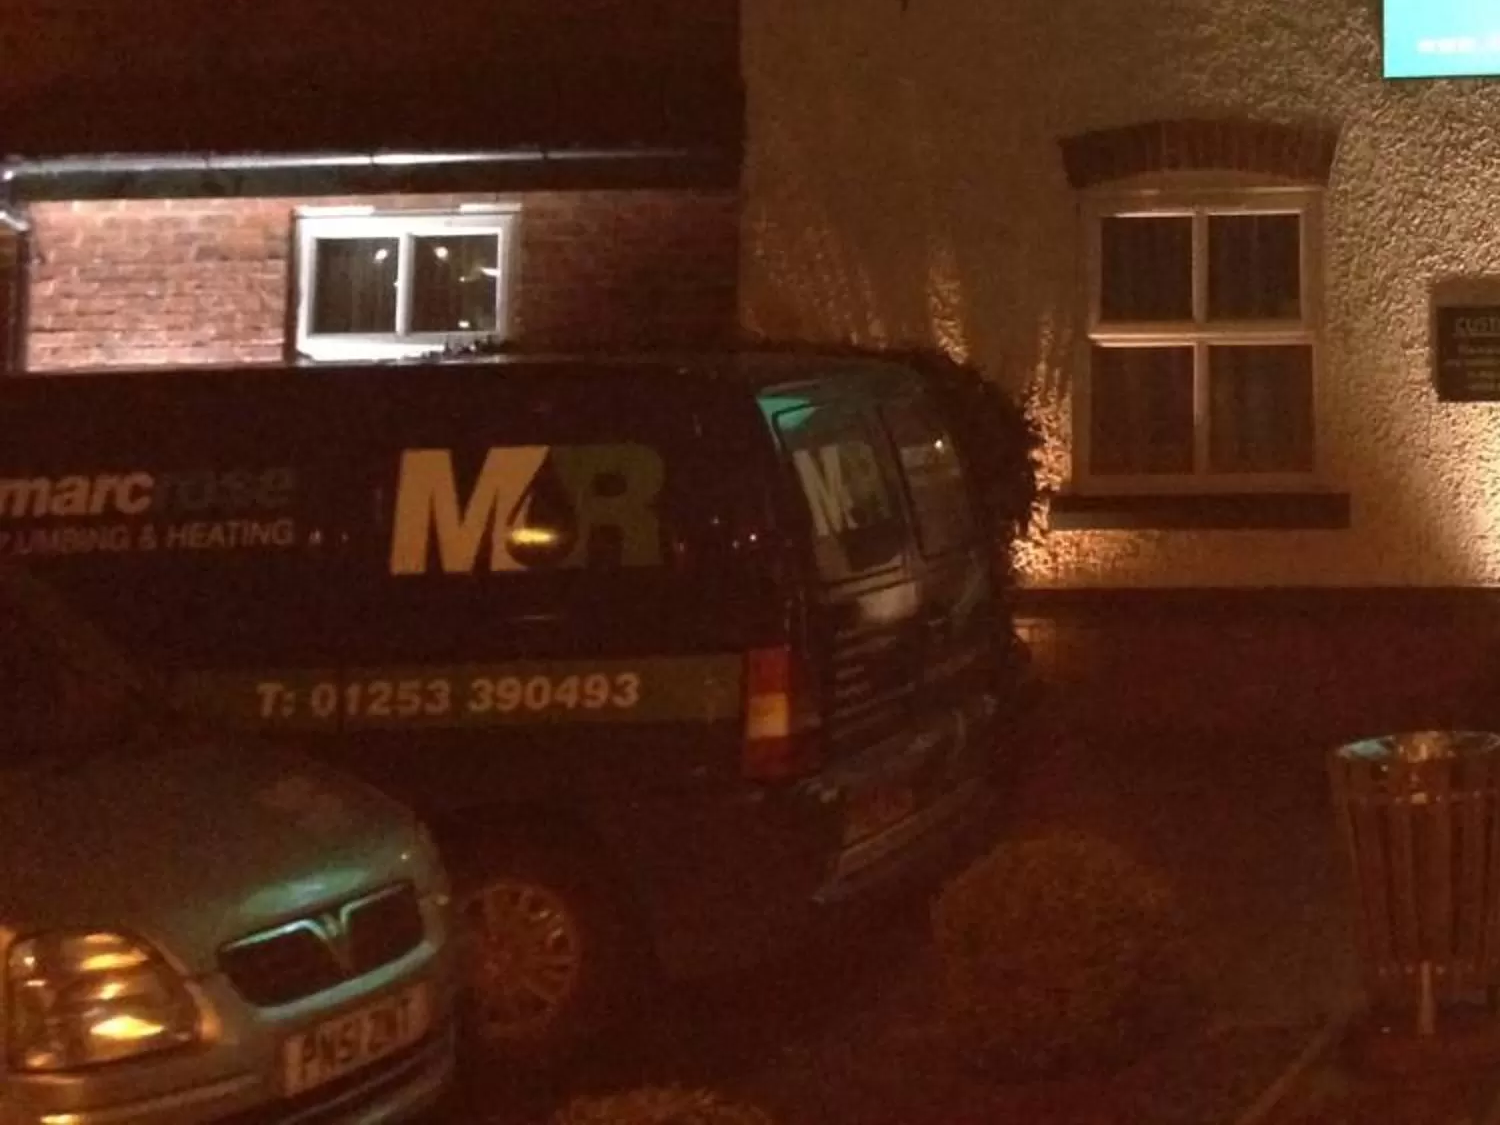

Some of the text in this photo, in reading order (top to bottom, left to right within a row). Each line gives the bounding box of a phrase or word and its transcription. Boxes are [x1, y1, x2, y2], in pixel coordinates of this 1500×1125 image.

[138, 523, 157, 551] &
[166, 515, 295, 549] HEATING
[255, 671, 643, 719] T: 01253 390493
